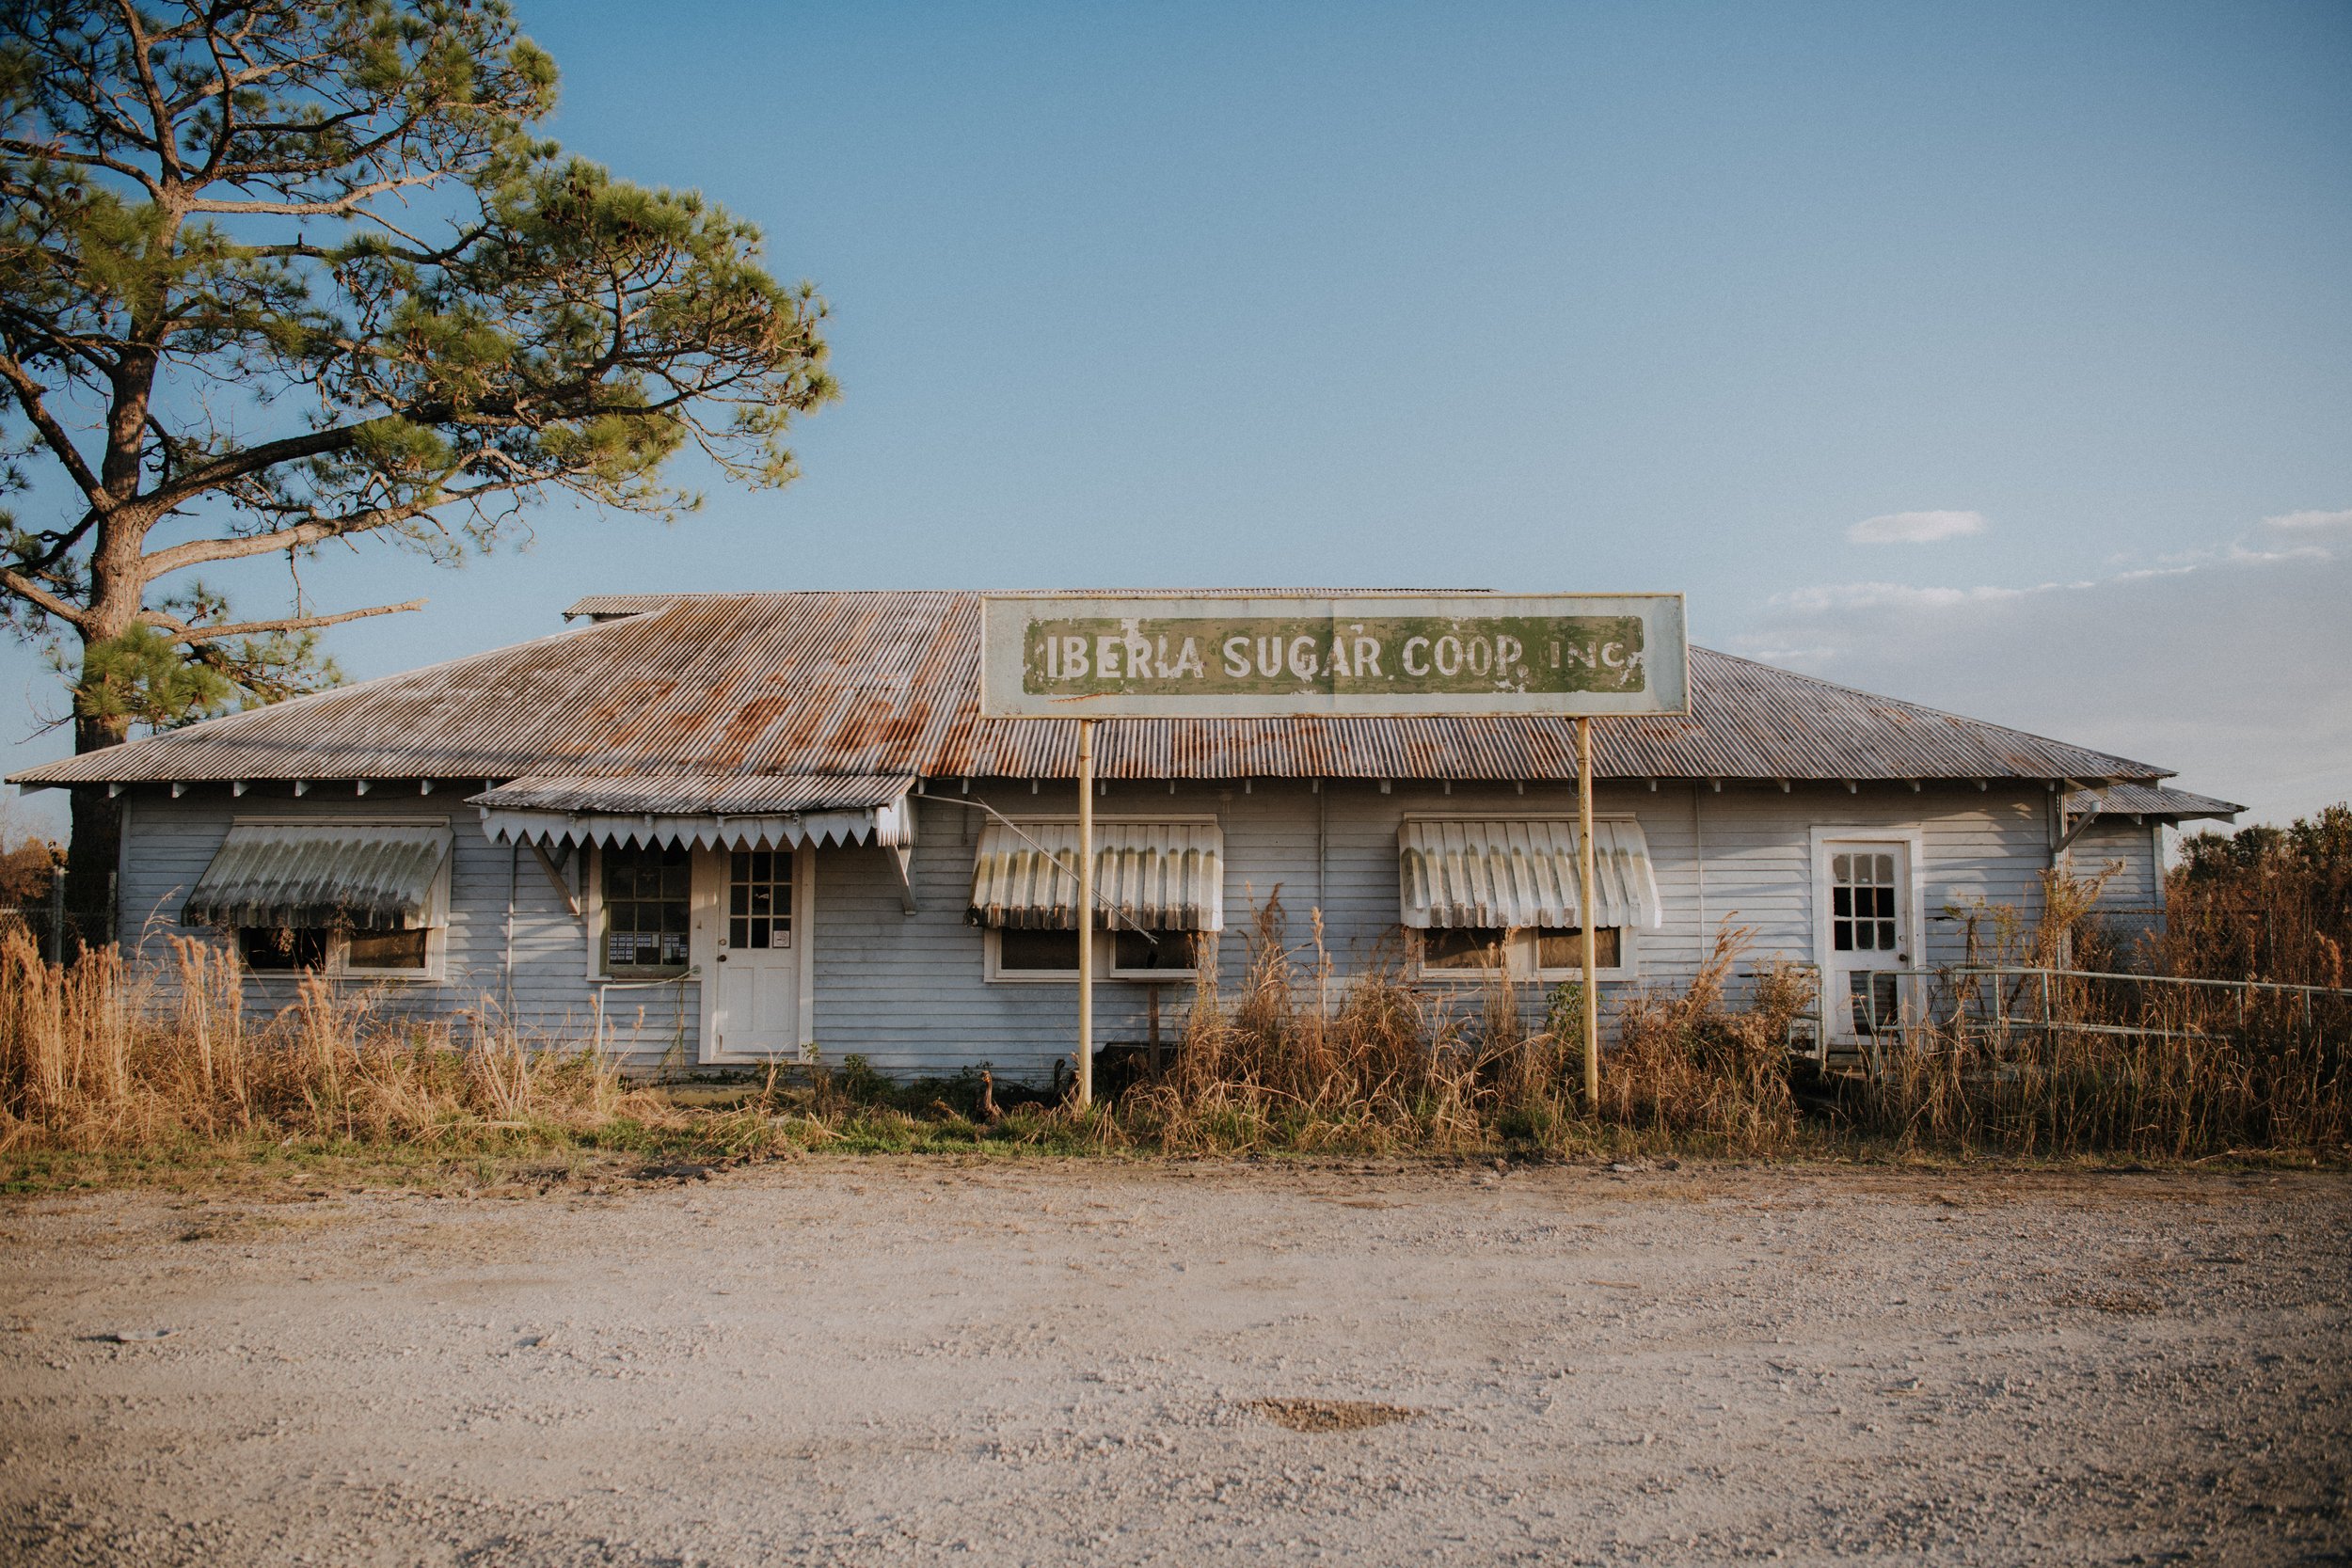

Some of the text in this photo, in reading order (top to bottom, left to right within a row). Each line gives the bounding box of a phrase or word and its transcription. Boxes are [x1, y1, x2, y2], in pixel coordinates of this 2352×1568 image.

[1047, 636, 1204, 678] IBERIA
[1223, 636, 1383, 678] SUGAR
[1402, 635, 1529, 677] COOP.
